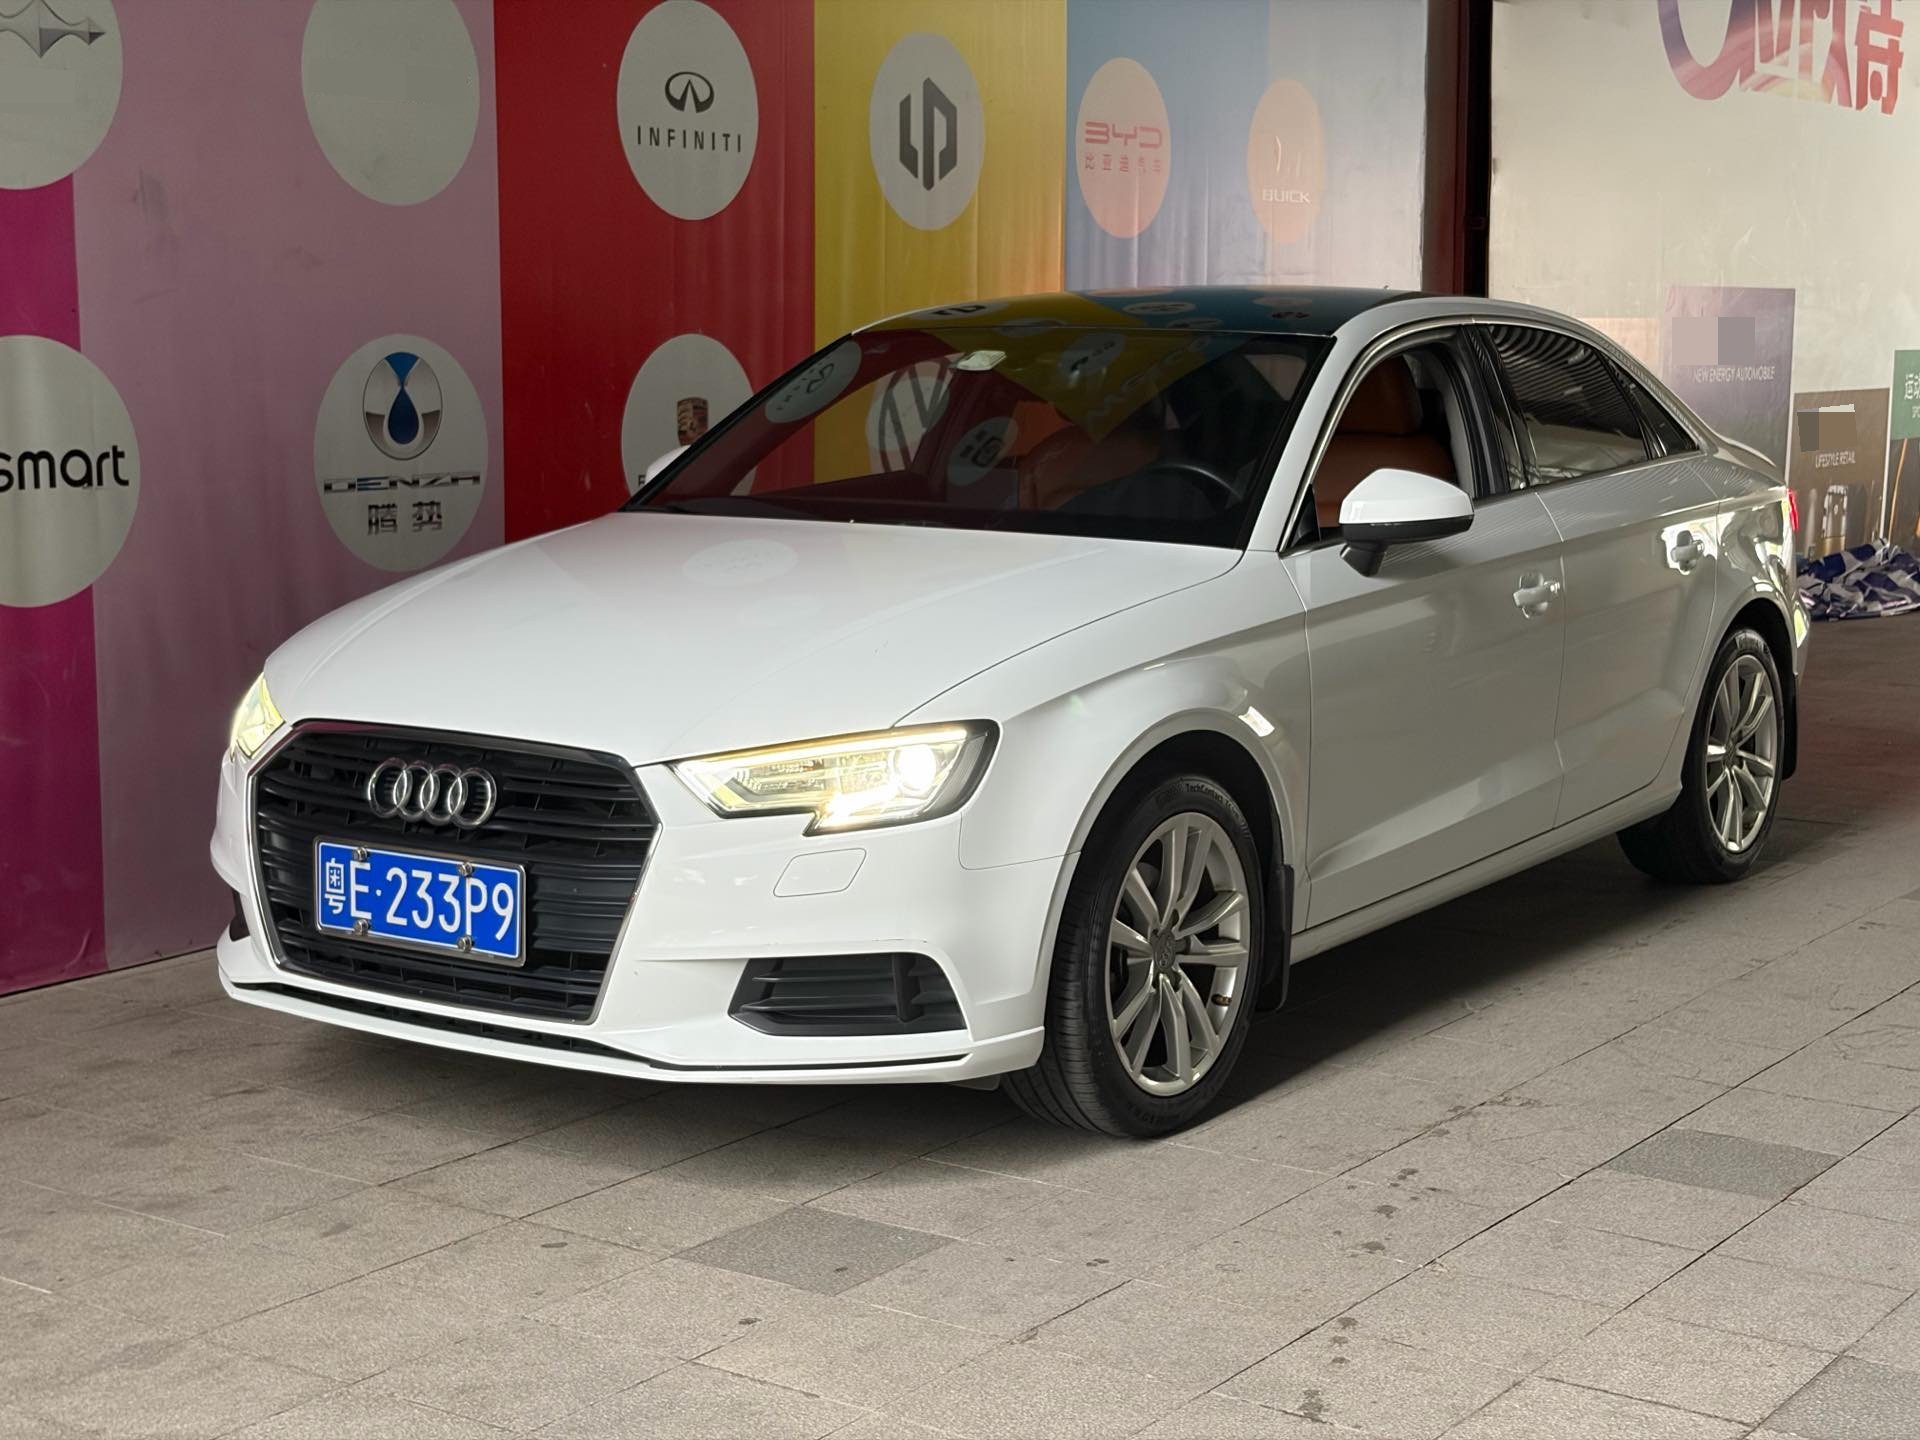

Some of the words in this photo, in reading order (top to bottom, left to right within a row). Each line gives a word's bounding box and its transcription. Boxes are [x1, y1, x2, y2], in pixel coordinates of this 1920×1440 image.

[637, 126, 741, 153] INFINITI
[1085, 121, 1162, 149] BYD
[1262, 188, 1311, 204] BUICK
[1695, 367, 1708, 383] NEW
[1710, 366, 1736, 382] ENERGY
[1737, 365, 1776, 381] AUTOMOBILE
[324, 473, 480, 494] DENZA
[324, 857, 514, 941] 粤E·233P9
